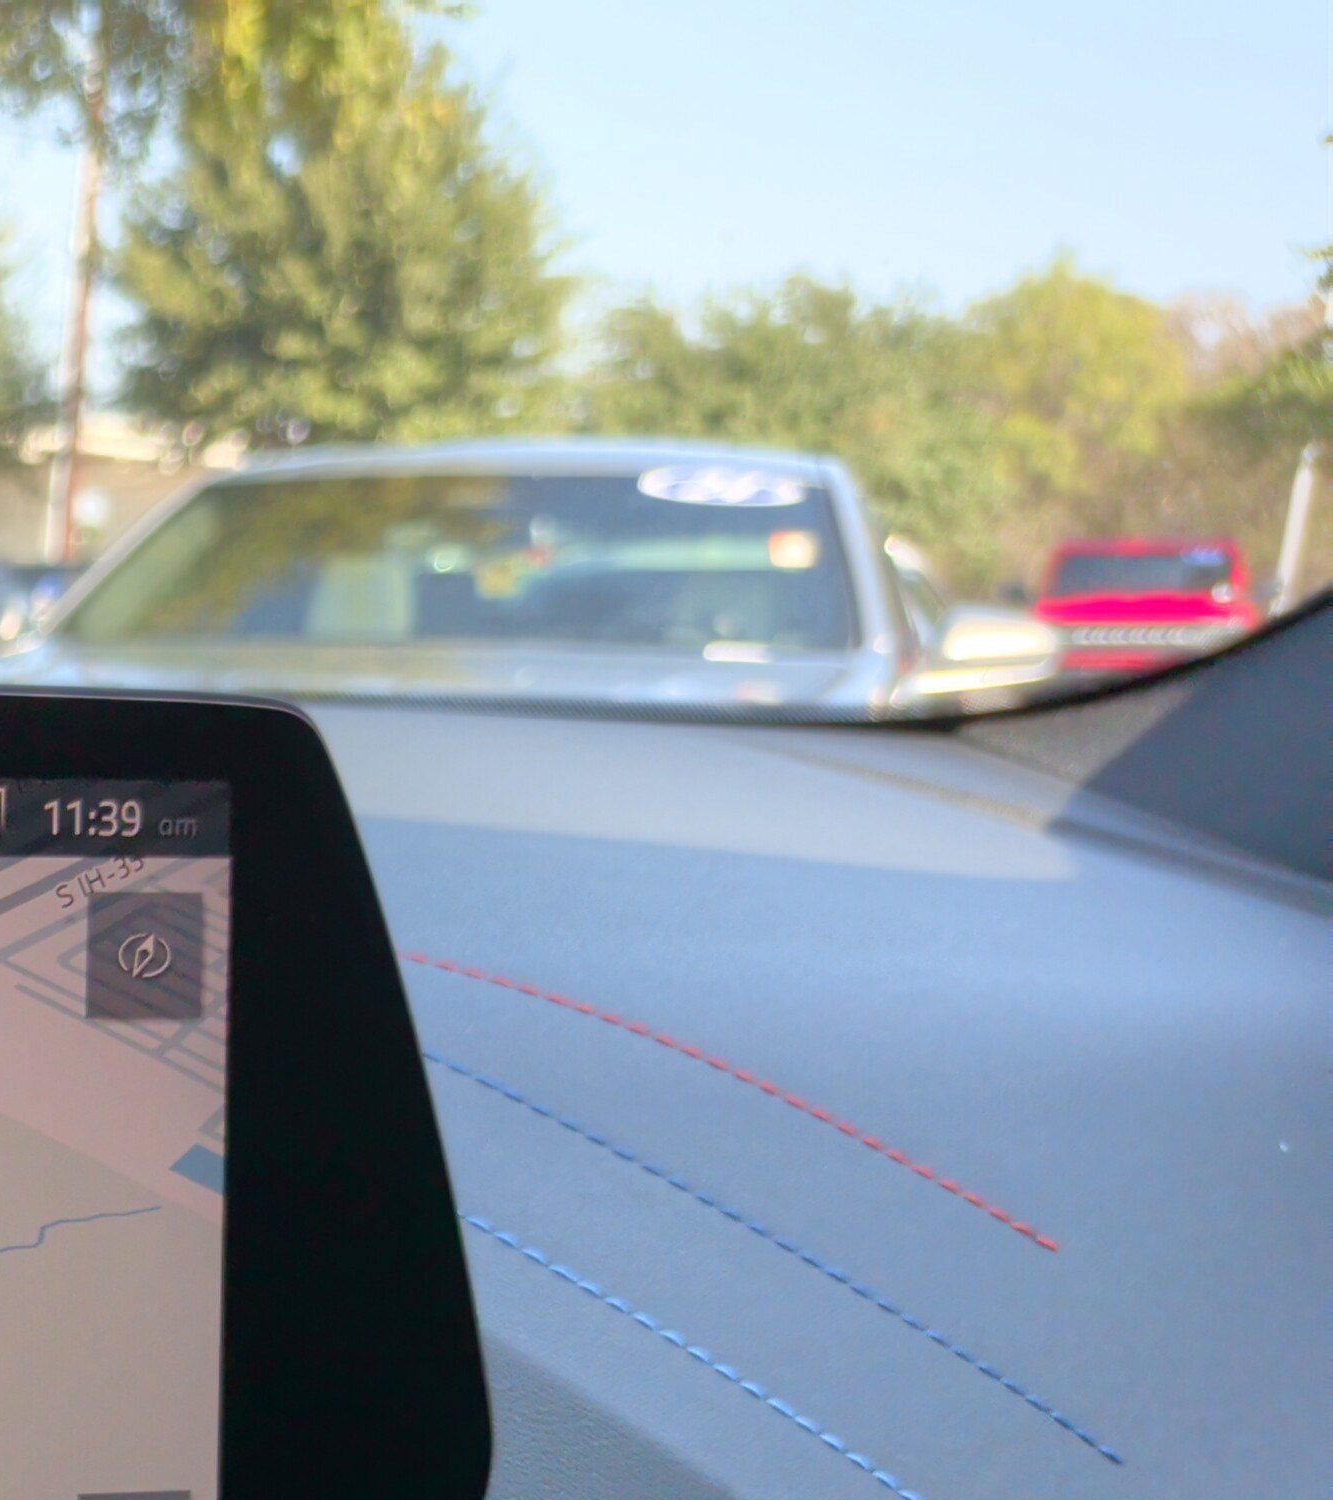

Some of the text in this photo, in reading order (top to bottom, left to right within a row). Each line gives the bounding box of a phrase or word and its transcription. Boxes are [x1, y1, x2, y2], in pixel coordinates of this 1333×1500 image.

[43, 799, 199, 839] 11:39 am
[54, 883, 75, 909] S
